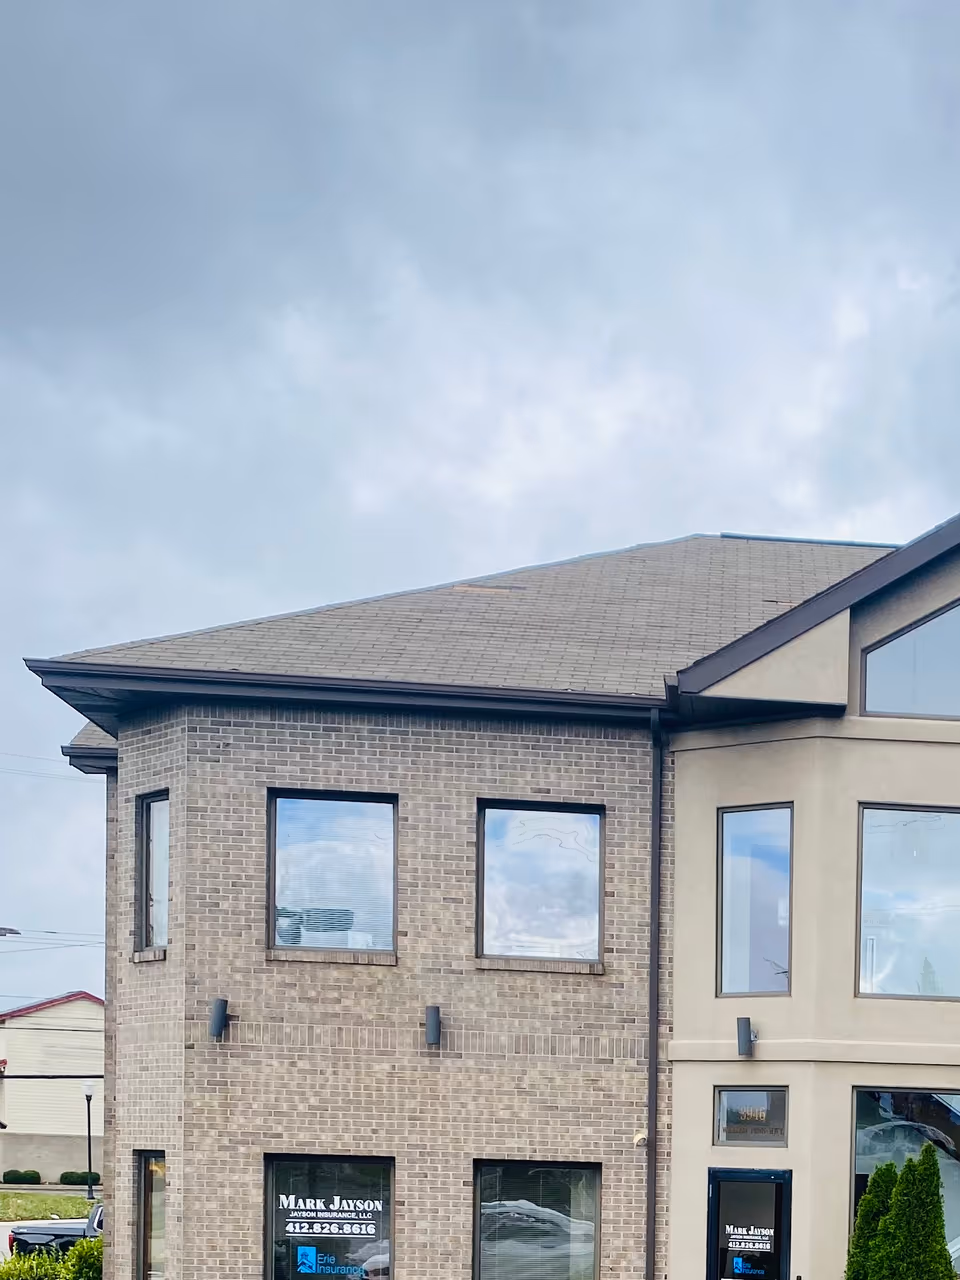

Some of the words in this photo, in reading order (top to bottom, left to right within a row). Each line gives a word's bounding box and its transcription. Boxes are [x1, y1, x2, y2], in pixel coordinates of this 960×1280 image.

[739, 1106, 767, 1122] 3946
[279, 1194, 327, 1210] MARK
[329, 1195, 384, 1212] JAYSON
[317, 1211, 358, 1219] INSURANCE,
[285, 1222, 376, 1235] 412.826.8616
[725, 1224, 748, 1235] MARK
[748, 1225, 775, 1236] JAYSON
[317, 1253, 336, 1264] Erie
[317, 1264, 366, 1276] Insurance
